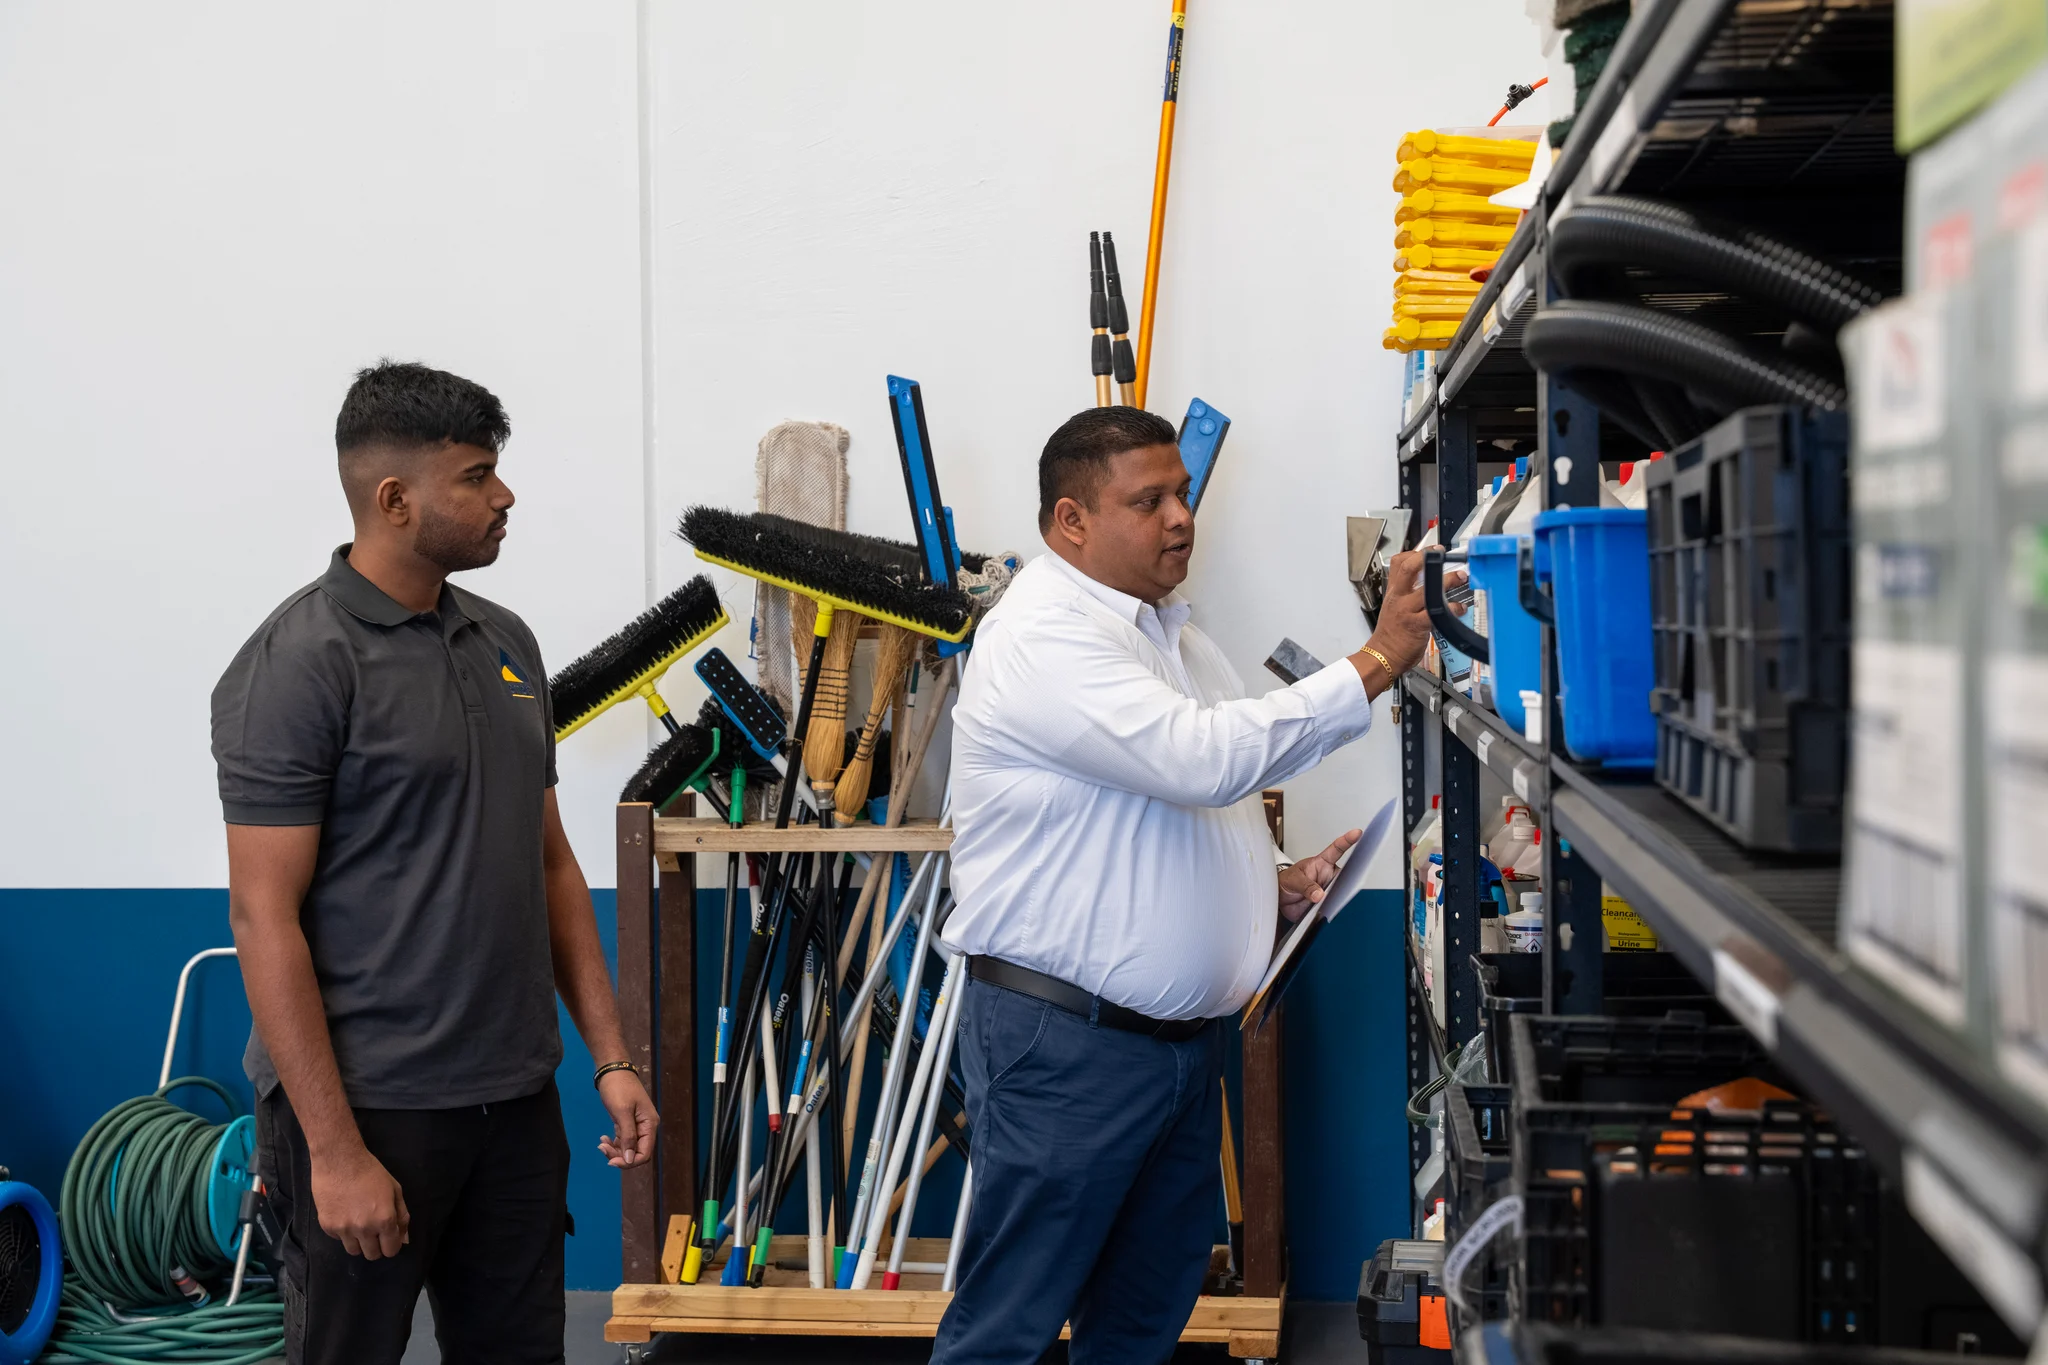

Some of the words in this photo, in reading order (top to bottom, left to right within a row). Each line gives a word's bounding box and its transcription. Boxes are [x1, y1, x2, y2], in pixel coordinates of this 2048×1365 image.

[1176, 14, 1185, 23] 27
[773, 993, 789, 1023] Oates
[805, 1084, 825, 1114] Oates
